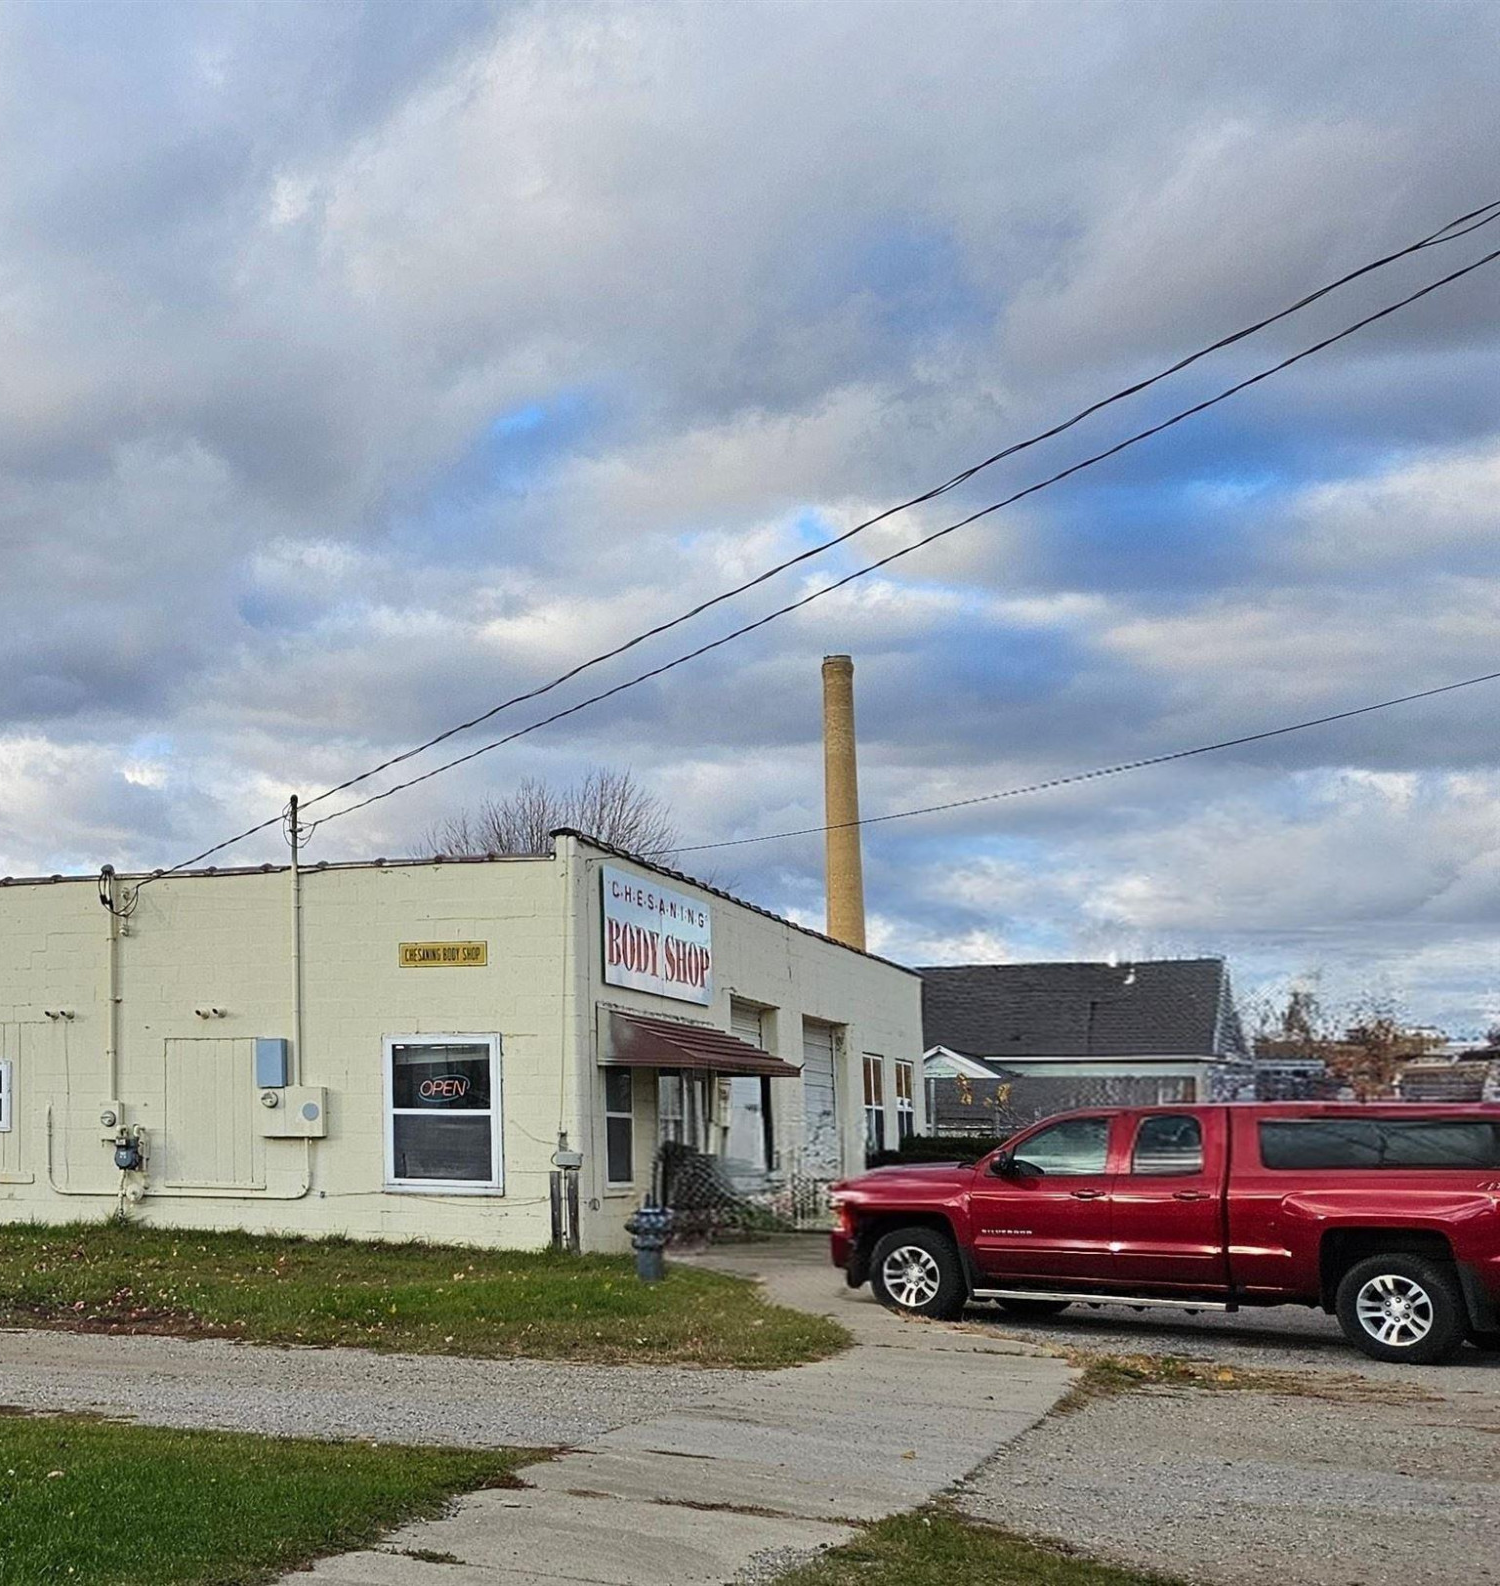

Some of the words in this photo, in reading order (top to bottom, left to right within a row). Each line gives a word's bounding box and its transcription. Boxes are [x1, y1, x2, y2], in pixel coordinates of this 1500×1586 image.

[443, 947, 460, 961] BODY
[463, 947, 480, 960] SHOP
[607, 916, 660, 978] BODY
[664, 933, 710, 988] SHOP
[420, 1080, 466, 1097] OPEN
